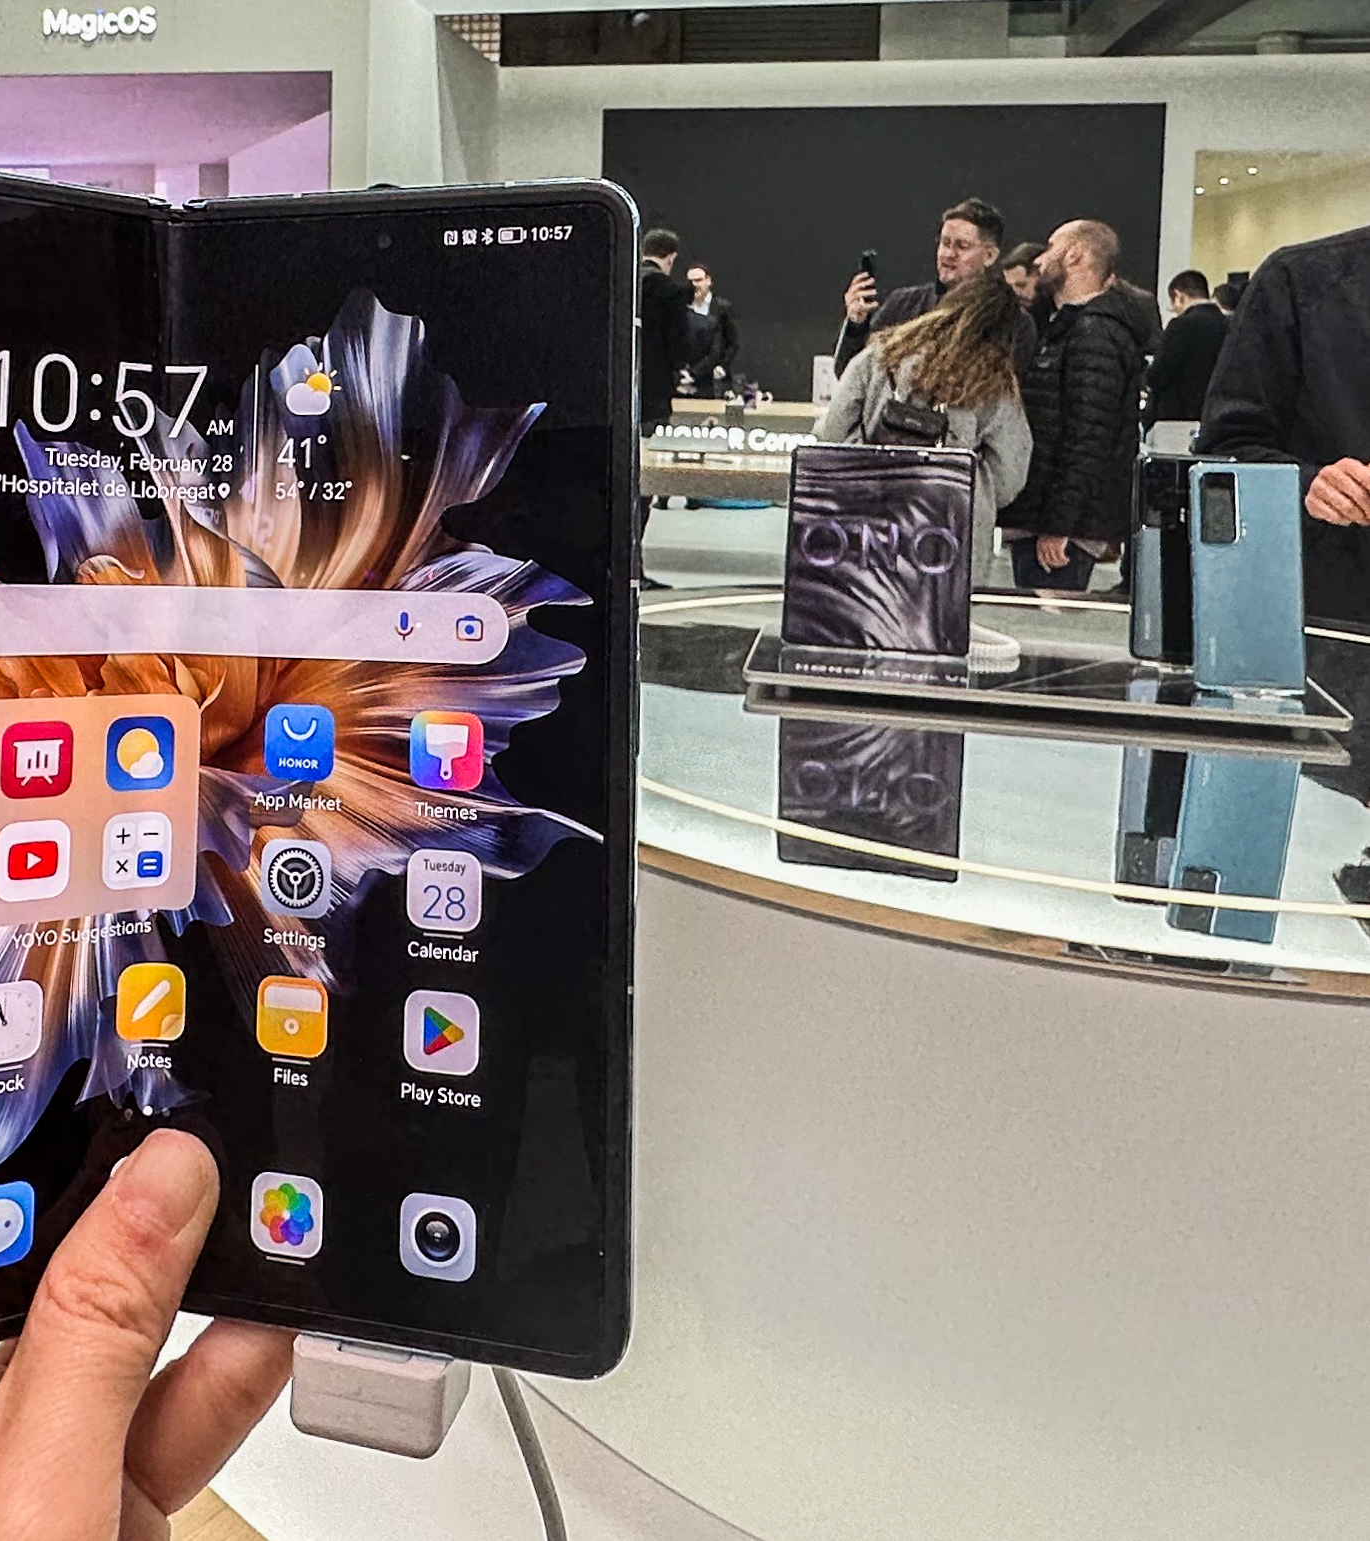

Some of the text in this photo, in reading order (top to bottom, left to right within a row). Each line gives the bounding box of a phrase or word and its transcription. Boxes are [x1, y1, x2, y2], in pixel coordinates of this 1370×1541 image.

[43, 5, 157, 41] MagicOS
[530, 225, 573, 242] 10:57
[206, 420, 234, 436] AM
[44, 447, 234, 477] Tuesday, February 28
[276, 433, 328, 469] 41°
[103, 479, 127, 498] de
[130, 480, 216, 504] Llobregat
[275, 480, 305, 500] 54°
[321, 480, 353, 501] 32°
[278, 757, 319, 770] HONOR
[254, 791, 342, 812] App Market
[415, 801, 478, 821] Themes
[423, 858, 467, 876] Tuesday
[422, 884, 466, 921] 28
[12, 920, 152, 949] YOYO Suggestions
[263, 927, 326, 951] Settings
[407, 940, 479, 963] Calendar
[126, 1053, 172, 1069] Notes
[273, 1067, 309, 1087] Files
[400, 1082, 482, 1108] Play Store
